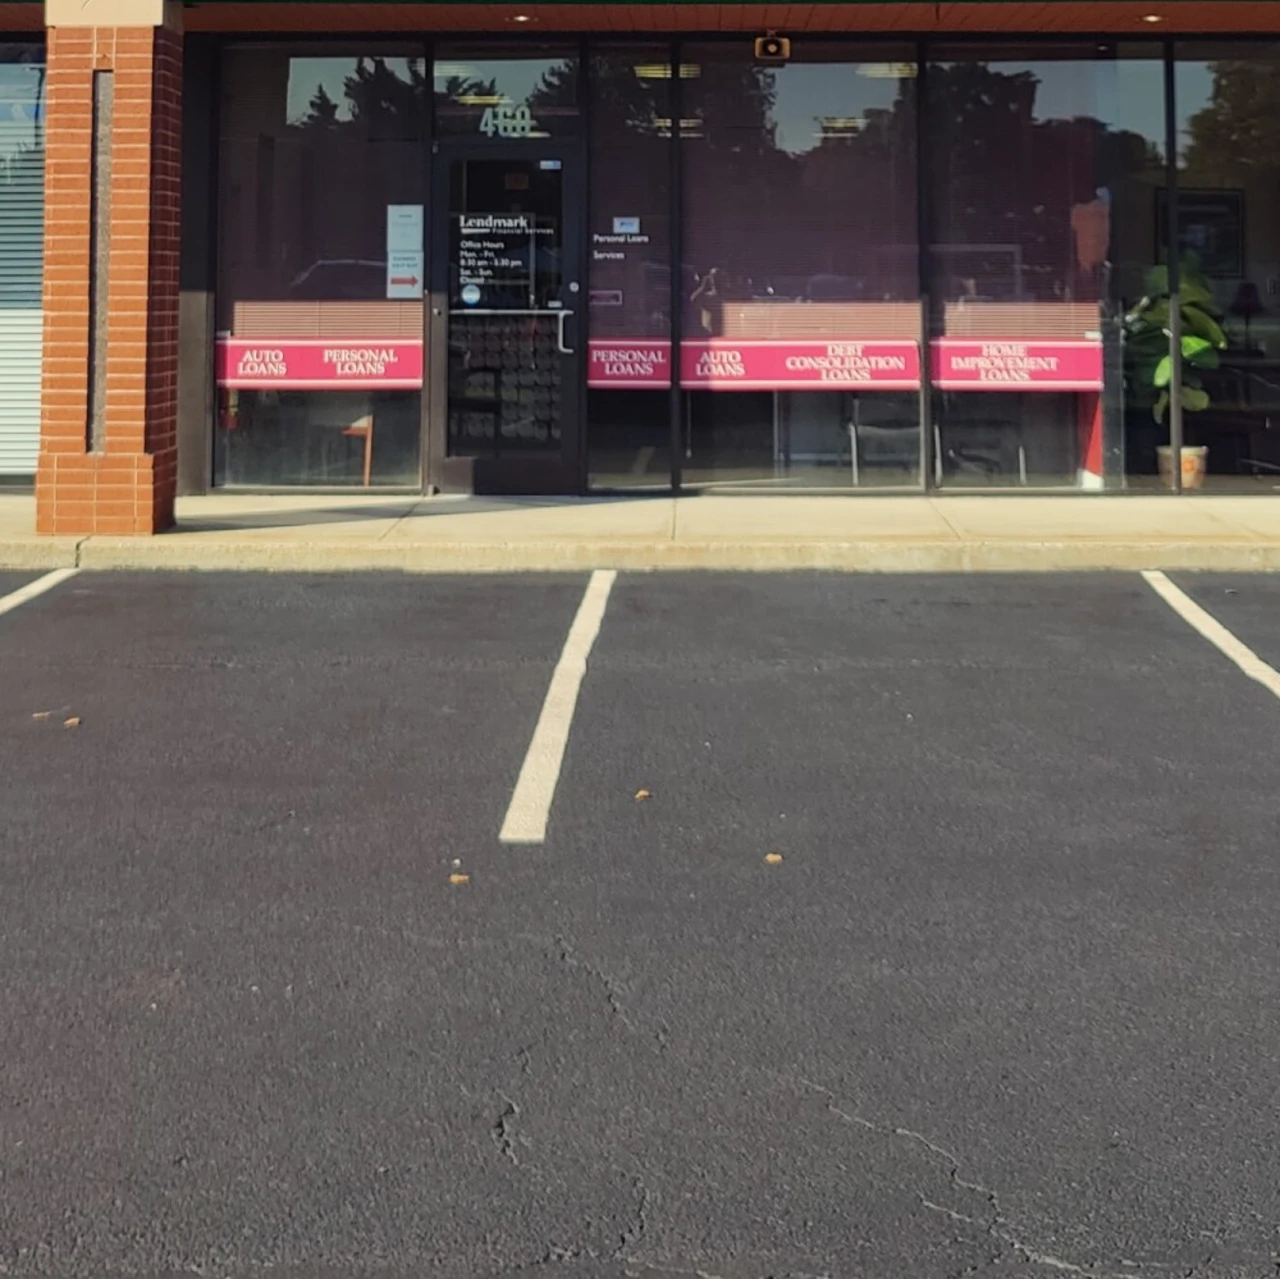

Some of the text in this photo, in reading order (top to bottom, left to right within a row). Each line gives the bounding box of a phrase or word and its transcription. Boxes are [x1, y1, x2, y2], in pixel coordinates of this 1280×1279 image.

[460, 215, 528, 228] Lendmark
[460, 241, 505, 249] Office Hours
[593, 234, 650, 243] Personal Loans
[593, 250, 625, 259] Services
[242, 349, 284, 362] AUTO
[323, 349, 399, 363] PERSONAL
[592, 350, 666, 363] PERSONAL
[700, 350, 741, 363] AUTO
[826, 344, 865, 356] DEBT
[981, 344, 1028, 356] HOME
[237, 362, 287, 375] LOANS
[336, 362, 385, 375] LOANS
[604, 362, 654, 375] LOANS
[696, 363, 745, 376] LOANS
[785, 356, 906, 370] CONSOLIDATION
[951, 356, 1059, 370] IMPROVEMENT
[821, 369, 871, 381] LOANS
[980, 369, 1031, 381] LOANS
